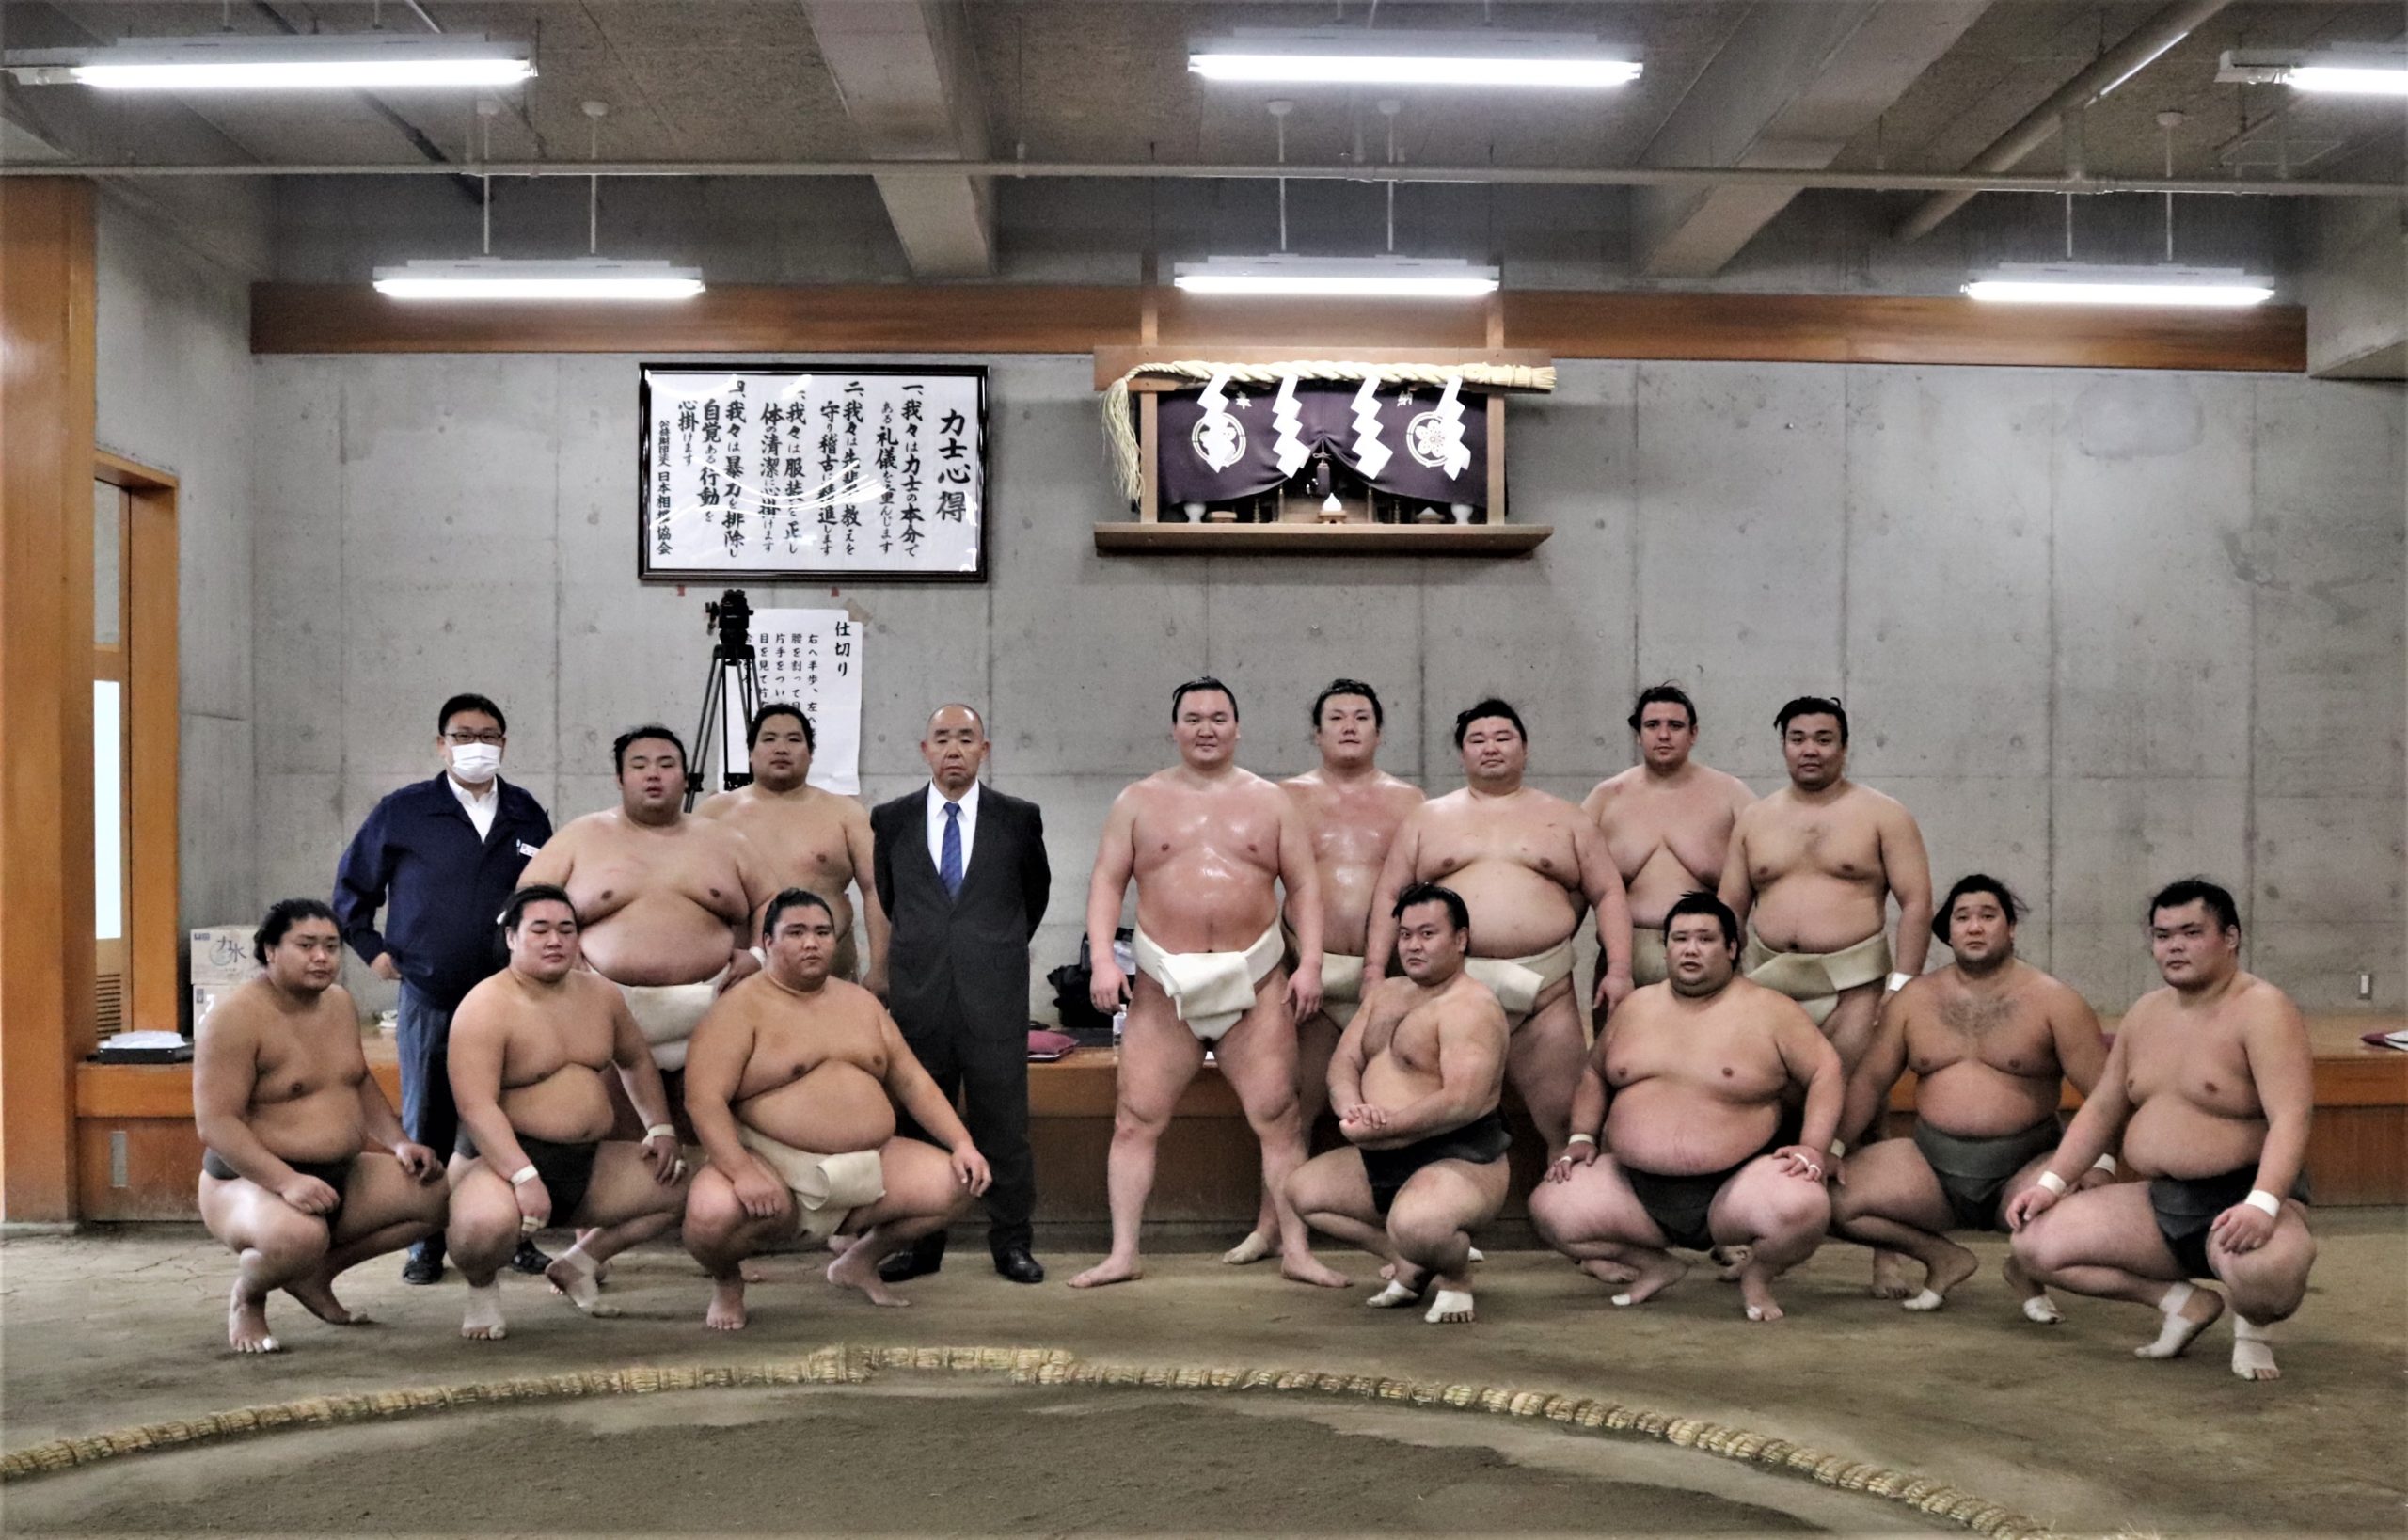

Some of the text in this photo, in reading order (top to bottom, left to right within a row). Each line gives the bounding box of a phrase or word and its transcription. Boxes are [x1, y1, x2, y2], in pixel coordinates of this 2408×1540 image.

[677, 400, 700, 466] 心掛けます
[698, 398, 722, 523] 自覚ある行動を
[784, 383, 807, 554] 、我々は服装を正し
[899, 384, 926, 557] 一、我々は力士の本分で
[937, 408, 972, 524] 力士心得
[775, 633, 786, 704] 片手をつい
[807, 633, 819, 750] 右へ半歩、左へ
[834, 621, 851, 677] 仕切り
